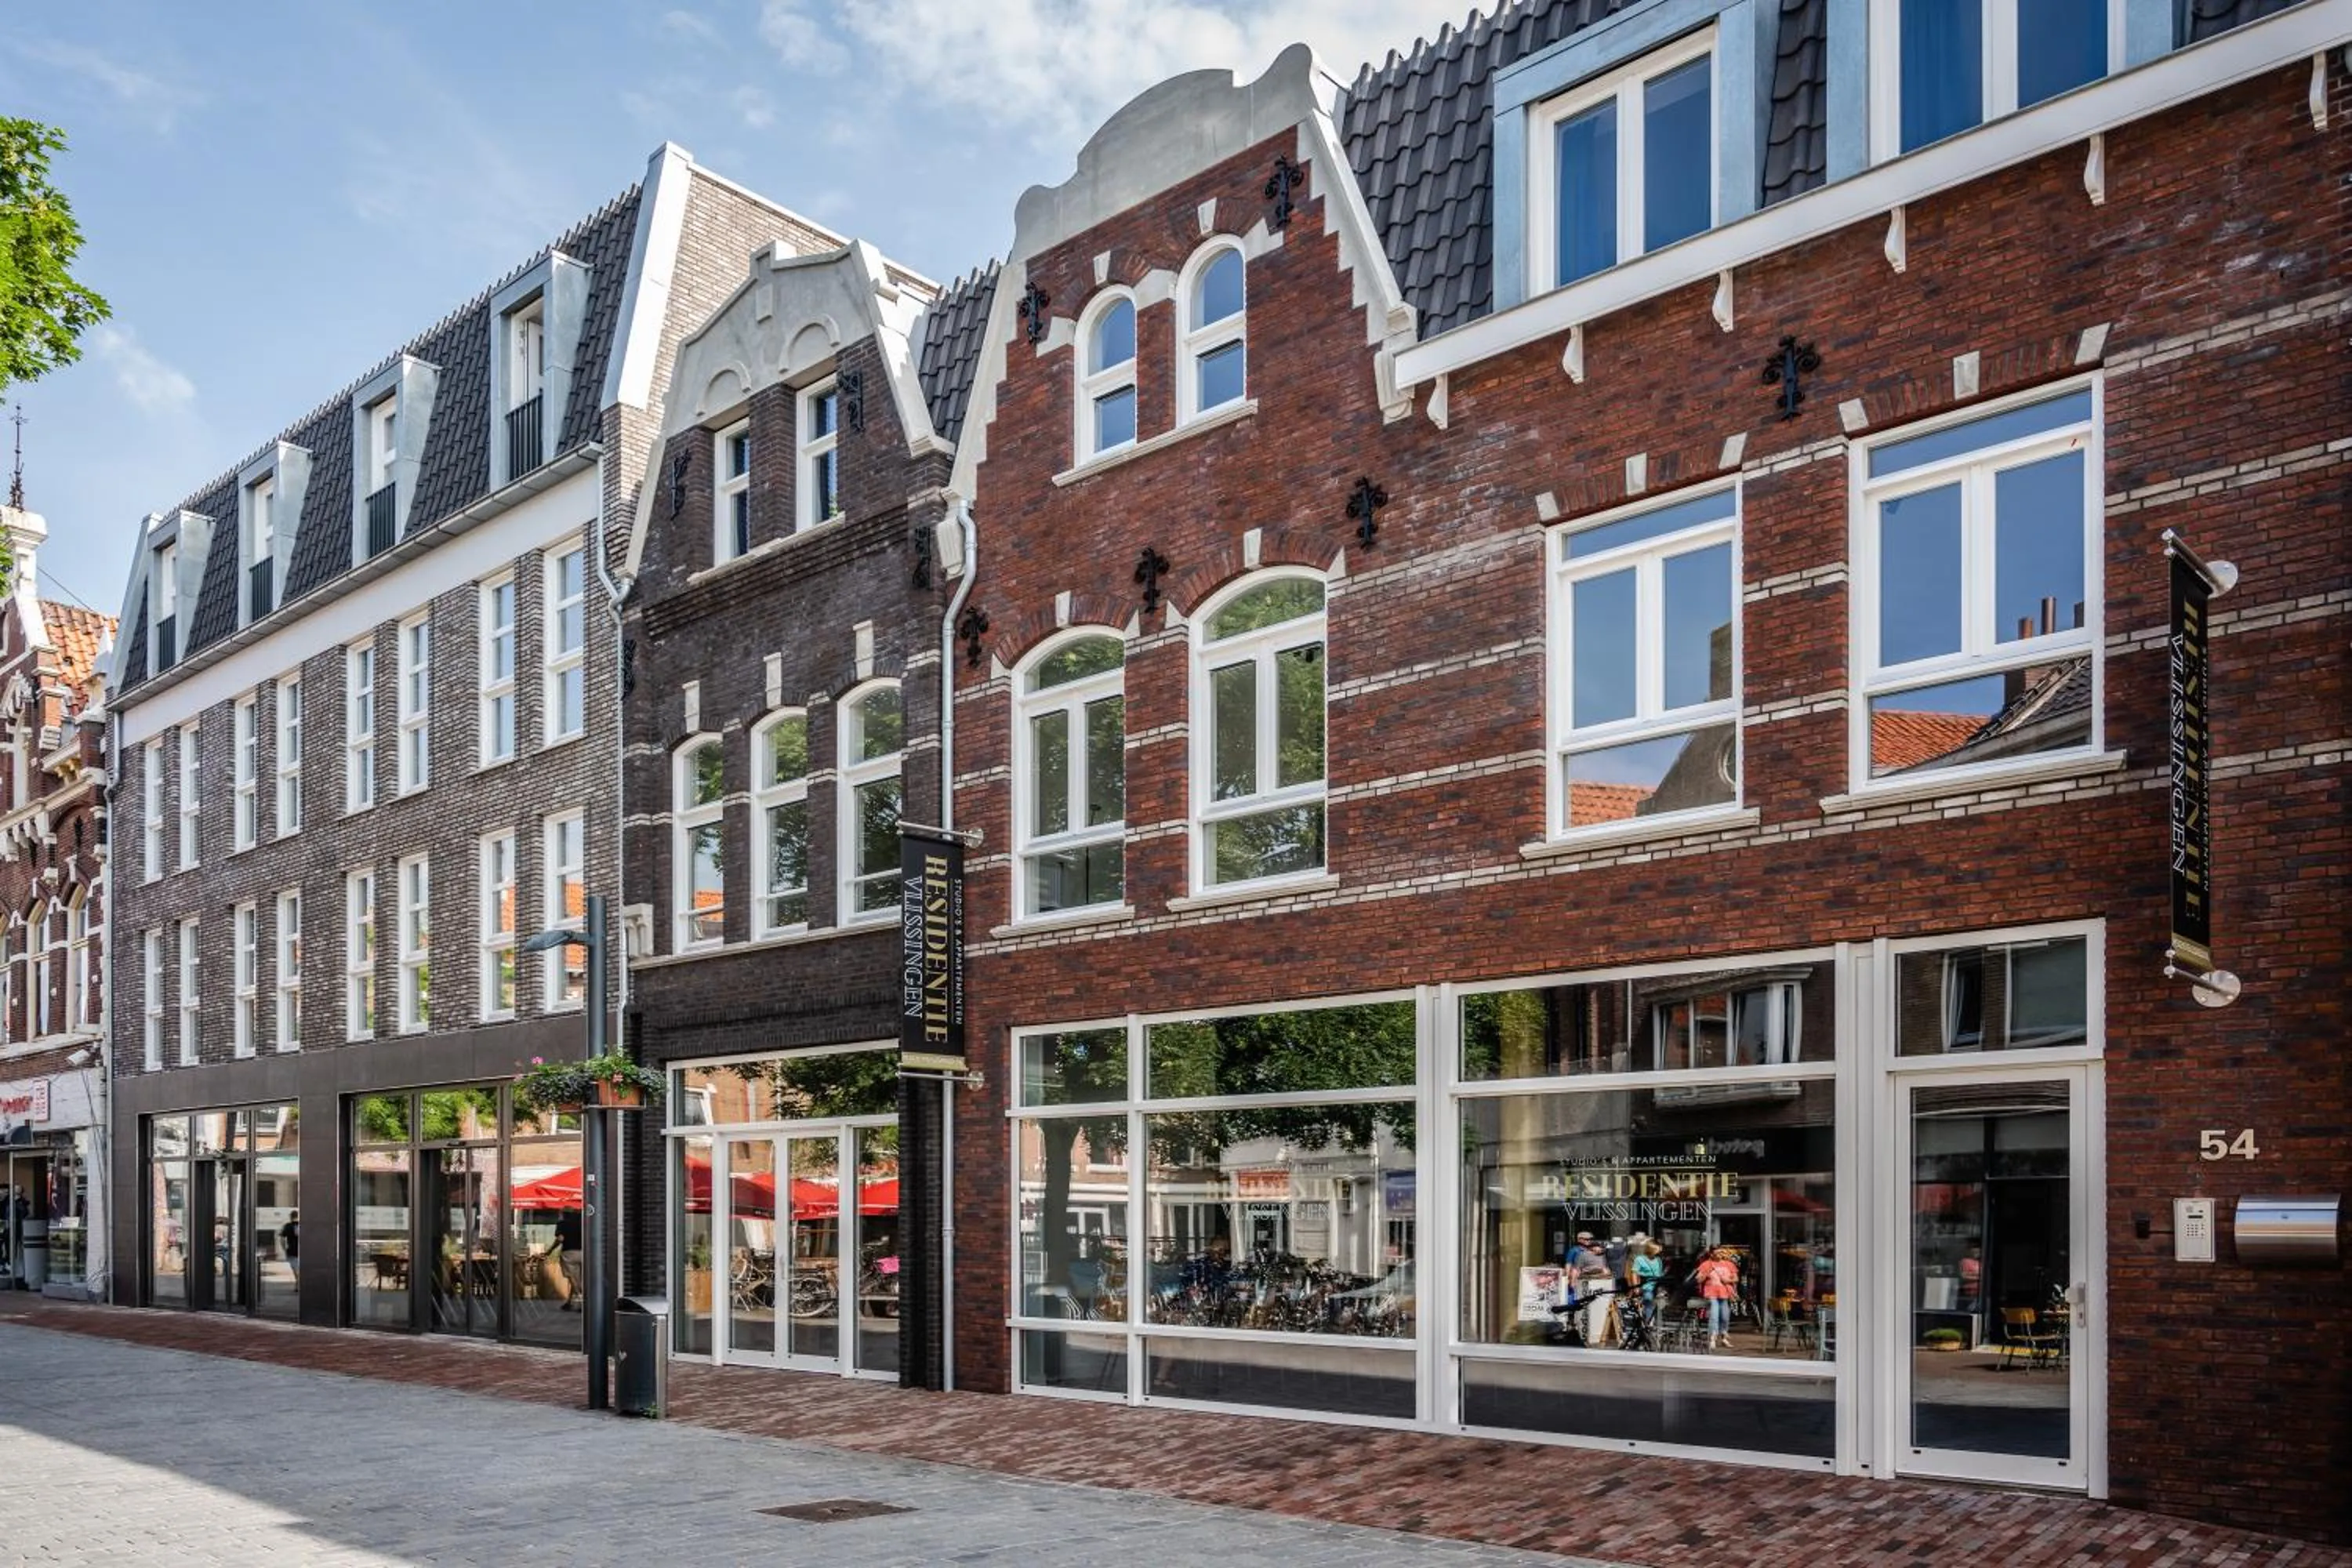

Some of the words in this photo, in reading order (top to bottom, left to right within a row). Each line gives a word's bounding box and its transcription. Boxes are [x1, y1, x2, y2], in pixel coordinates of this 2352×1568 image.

[2171, 633, 2186, 877] VLISSINGEN
[2183, 594, 2201, 922] RESIDENTIE
[953, 878, 963, 925] STUDIO'S
[903, 874, 924, 1019] VLISSINGEN
[924, 853, 949, 1043] RESIDENTIE
[953, 938, 964, 1025] APPARTEMENTEN
[1621, 1154, 1717, 1165] APPARTEMENTEN
[2200, 1128, 2260, 1160] 54
[1541, 1171, 1739, 1200] RESIDENTIE
[1563, 1200, 1712, 1221] VLISSINGEN
